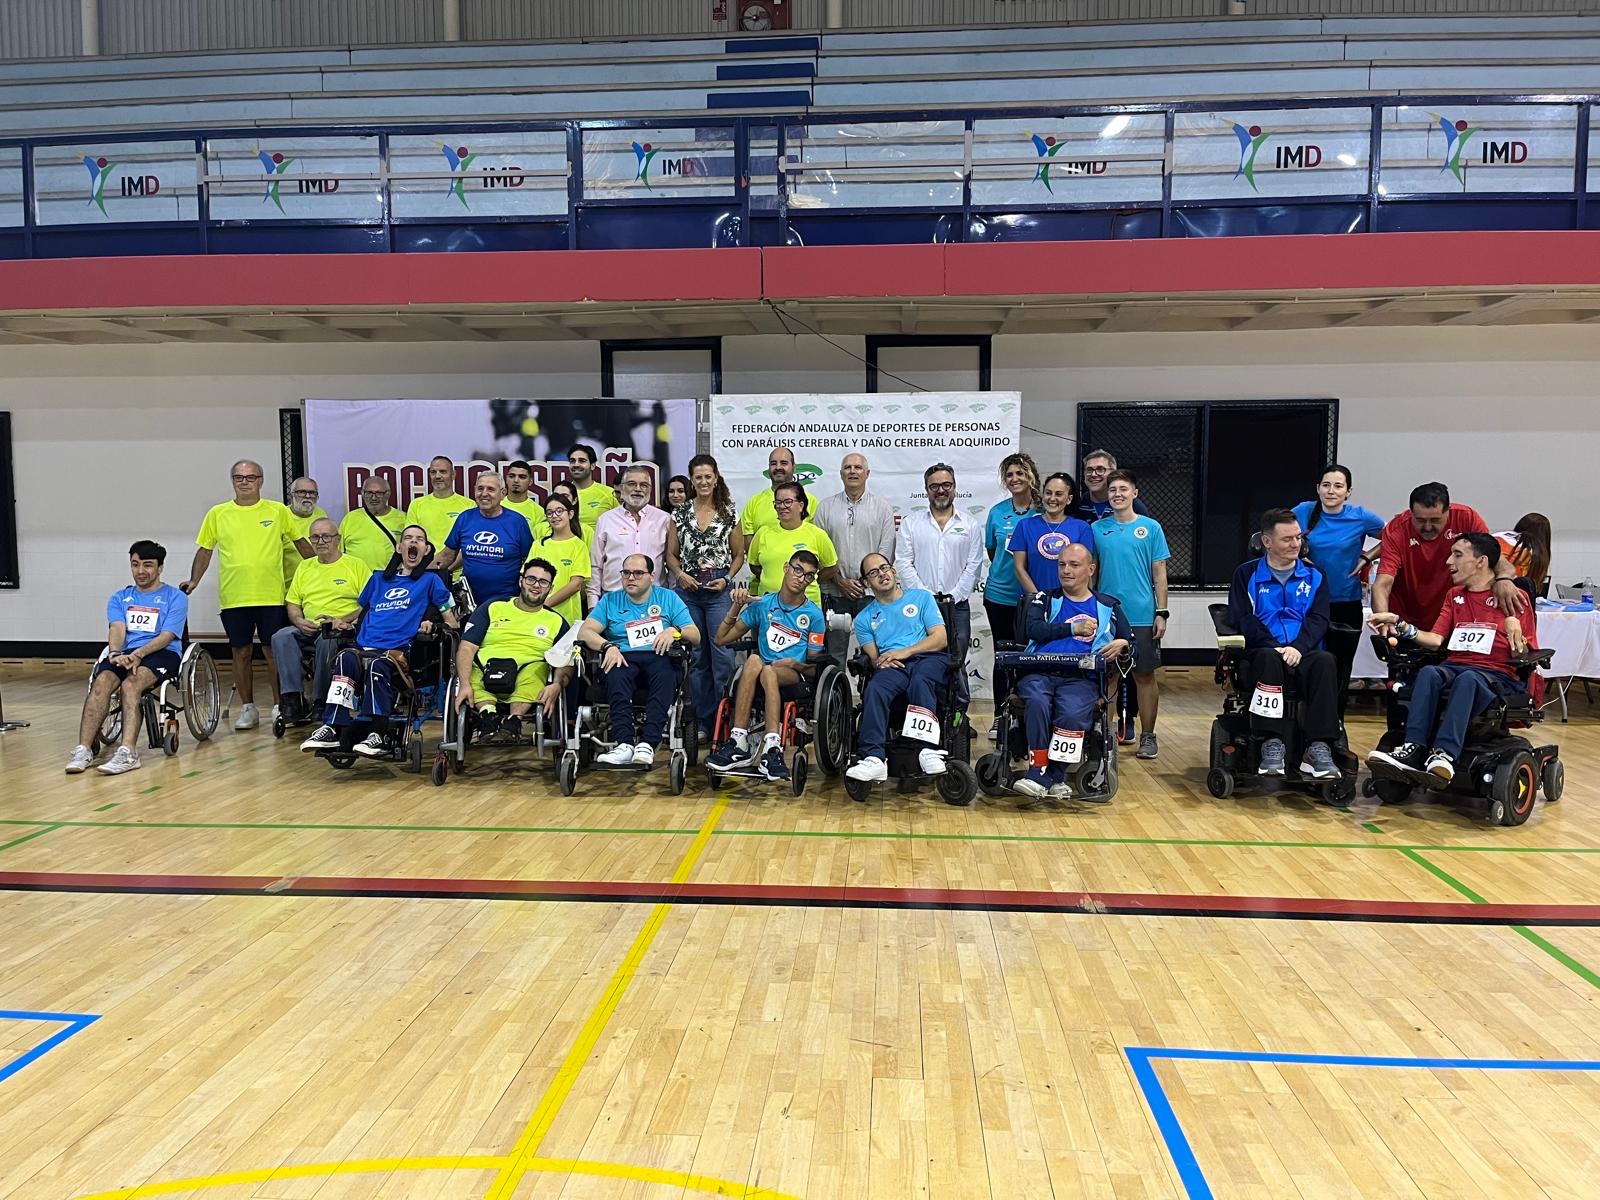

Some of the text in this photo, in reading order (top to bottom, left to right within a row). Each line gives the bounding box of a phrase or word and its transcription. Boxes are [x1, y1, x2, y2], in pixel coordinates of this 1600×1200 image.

[1276, 145, 1322, 168] IMD
[1483, 141, 1528, 164] IMD
[662, 158, 696, 177] IMD
[1068, 160, 1108, 175] IMD
[482, 166, 525, 188] IMD
[121, 175, 160, 197] IMD
[298, 178, 340, 194] IMD
[732, 422, 1001, 433] FEDERACIÓN ANDALUZA DE DEPORTES DE PERSONAS
[722, 436, 1011, 448] CON PARÁLISIS CEREBRAL Y DAÑO CEREBRAL ADQUIRIDO
[466, 544, 504, 554] HYUNDAI
[375, 598, 411, 609] HYUNDAI
[130, 614, 150, 625] 102
[635, 626, 657, 640] 204
[1458, 632, 1486, 643] 307
[334, 685, 352, 701] 301
[1256, 694, 1279, 709] 310
[911, 718, 933, 733] 101
[1052, 739, 1077, 754] 309
